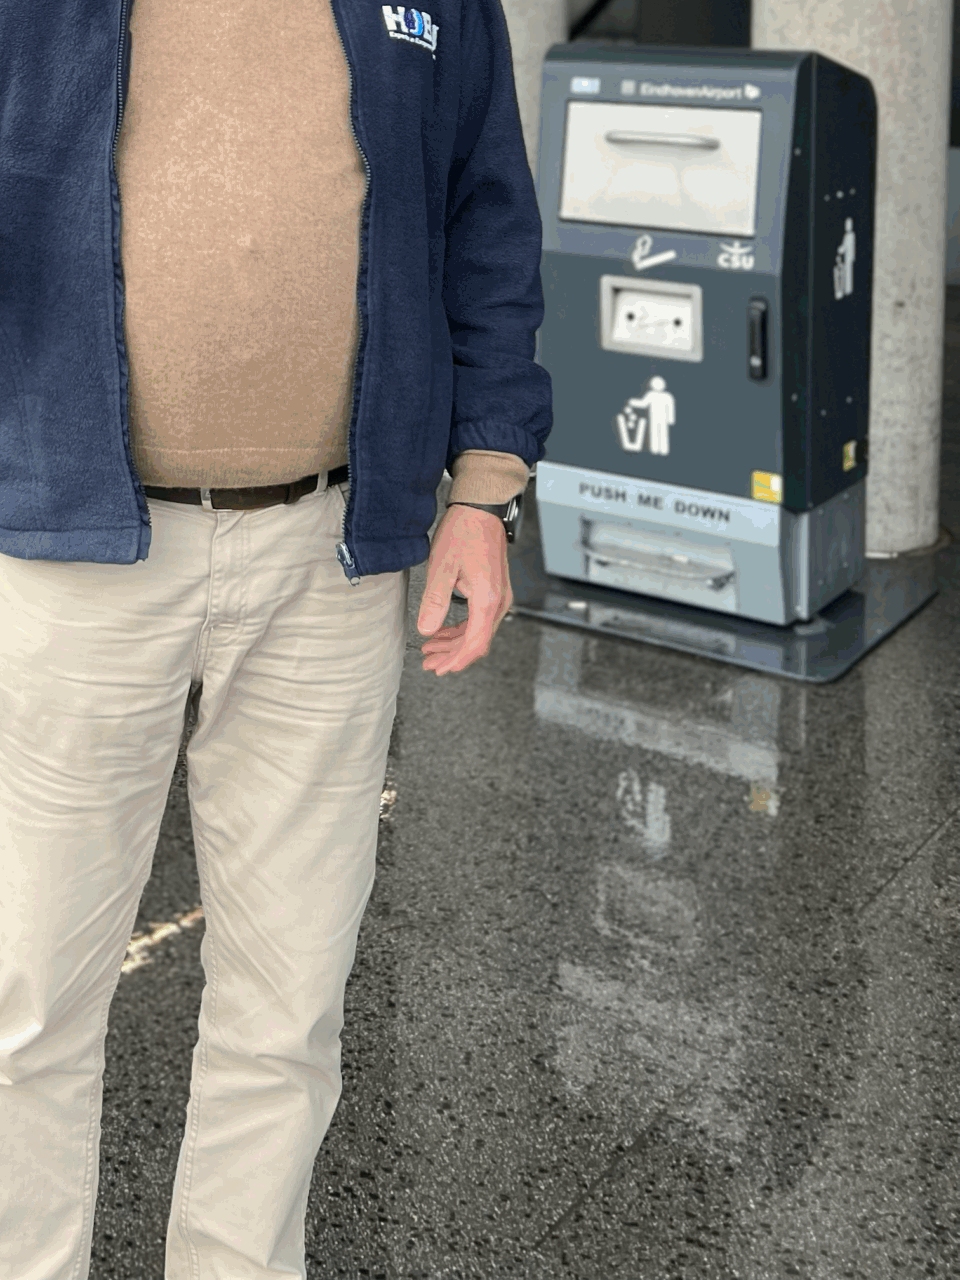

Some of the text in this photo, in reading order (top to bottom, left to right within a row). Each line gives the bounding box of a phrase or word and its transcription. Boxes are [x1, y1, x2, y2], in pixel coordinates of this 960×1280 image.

[716, 252, 755, 271] CSU
[579, 481, 732, 523] PUSH ME DOWN
